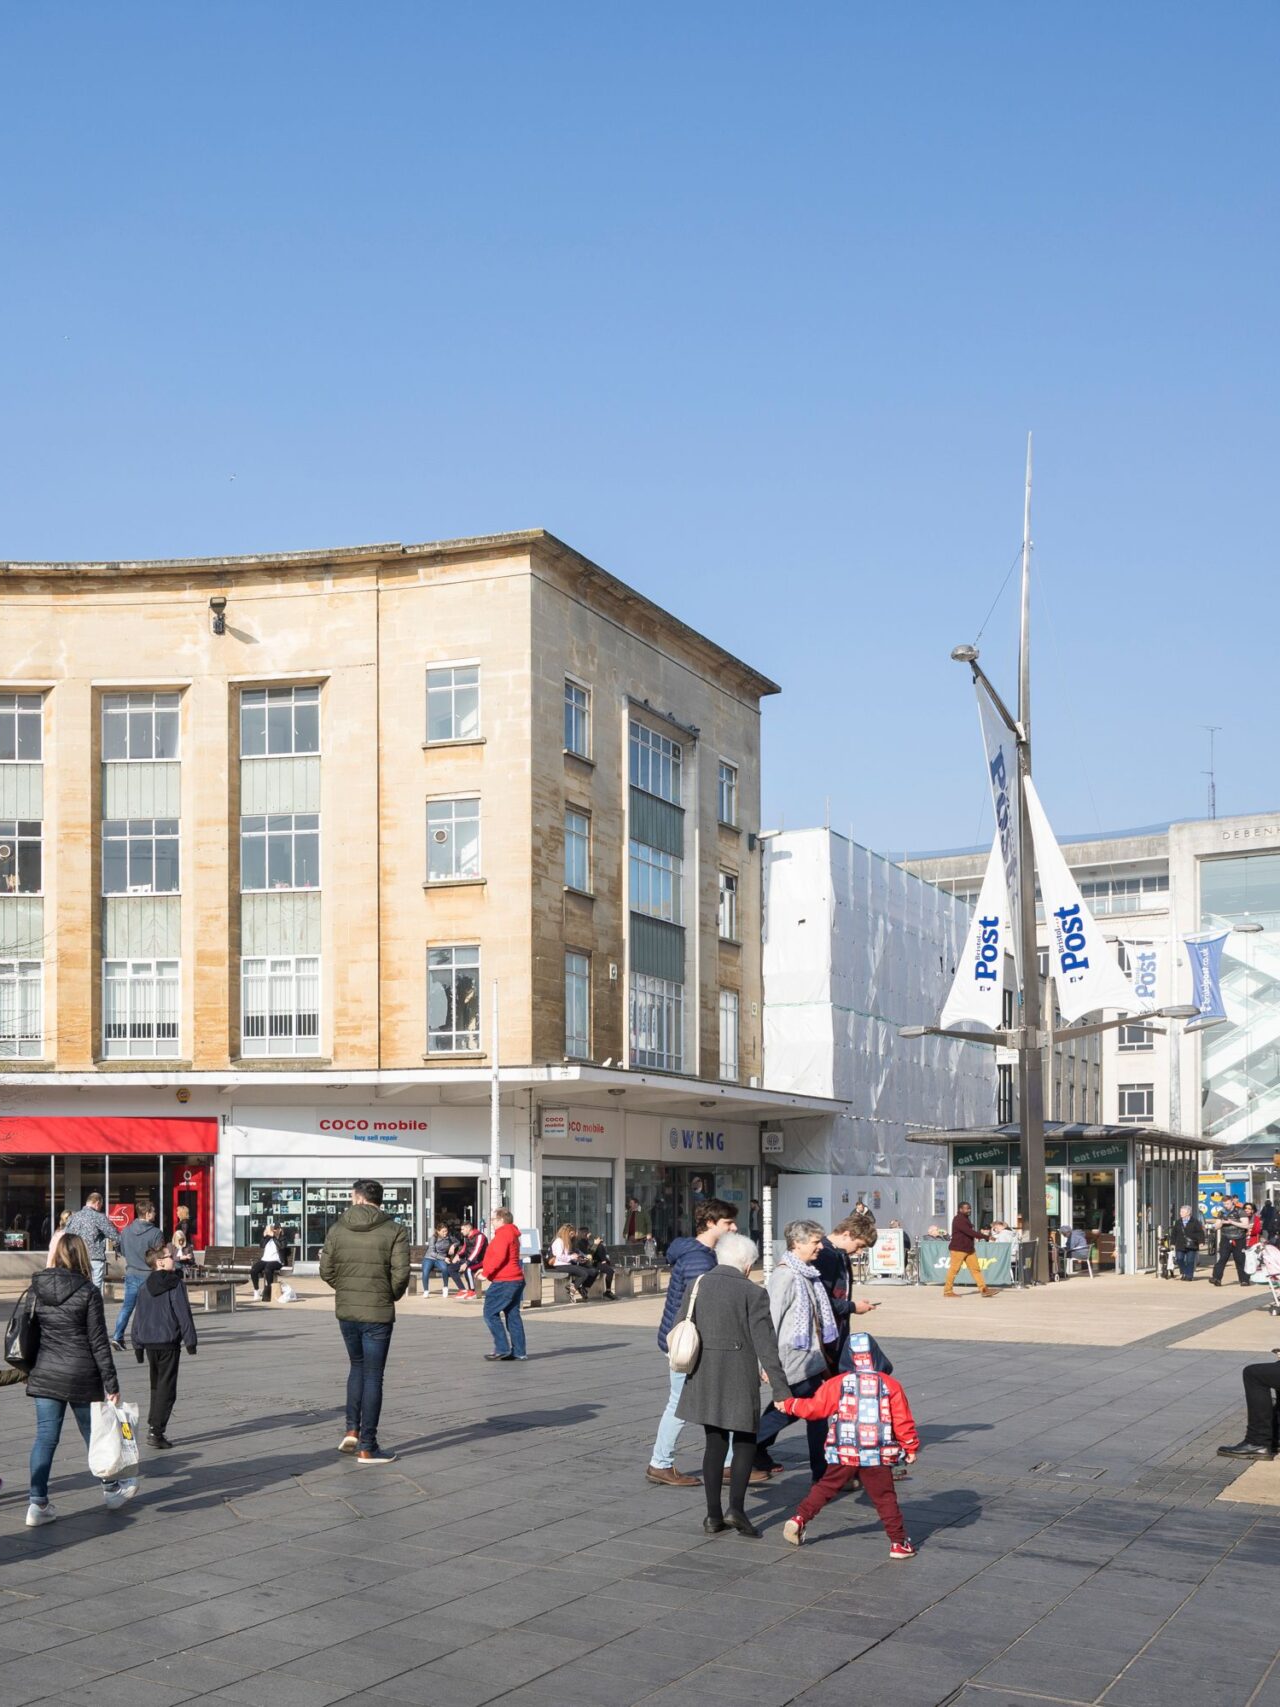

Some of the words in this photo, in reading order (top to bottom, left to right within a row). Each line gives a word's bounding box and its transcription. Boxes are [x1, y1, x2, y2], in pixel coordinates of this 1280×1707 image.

[1053, 903, 1090, 974] Post
[975, 916, 1000, 981] Post
[1135, 952, 1157, 998] Post
[319, 1119, 369, 1130] COCO
[373, 1119, 428, 1130] mobile
[582, 1122, 605, 1133] mobile
[681, 1129, 724, 1151] WENG
[958, 1154, 974, 1164] eat
[1073, 1152, 1090, 1163] eat
